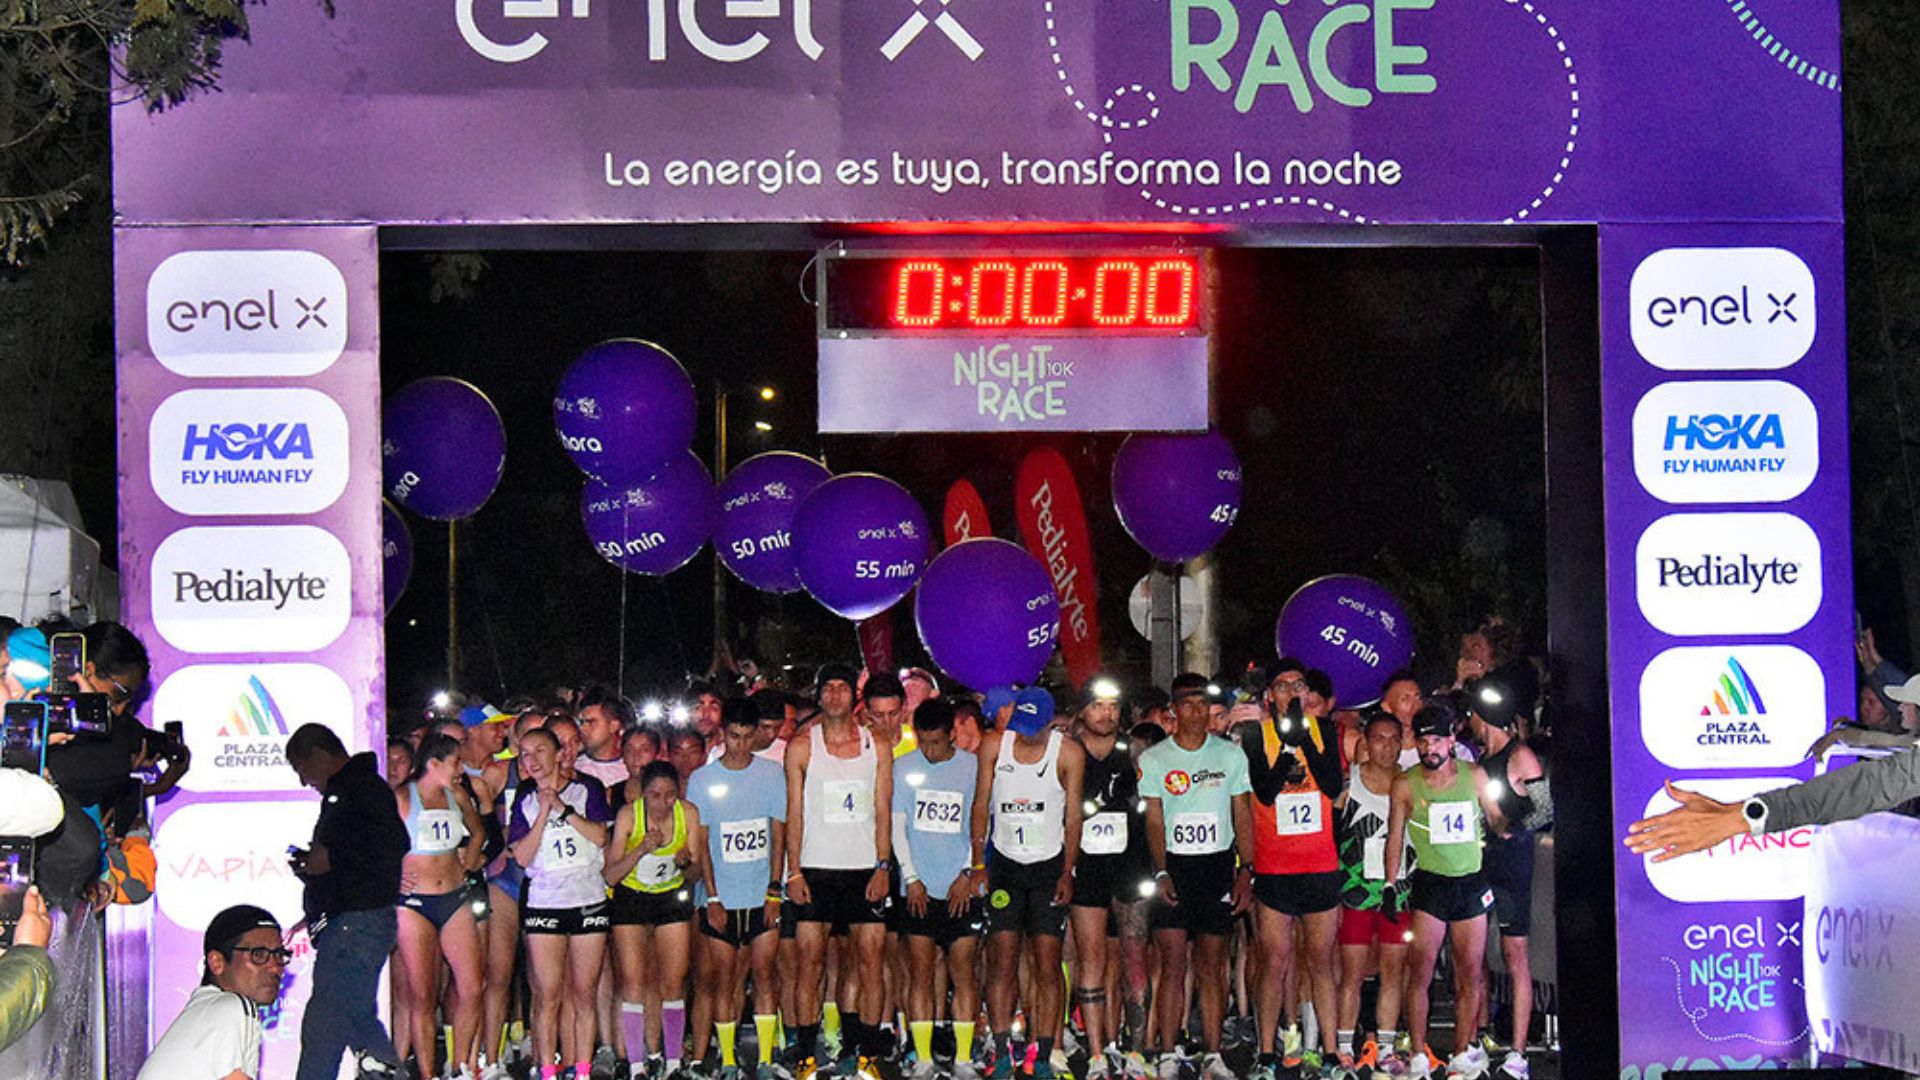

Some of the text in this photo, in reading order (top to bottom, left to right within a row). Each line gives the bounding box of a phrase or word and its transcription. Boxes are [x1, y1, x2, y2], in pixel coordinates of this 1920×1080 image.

[1171, 0, 1437, 113] RACE
[605, 150, 1402, 194] La energía es tuya, transforma la noche
[166, 289, 279, 333] enel
[1648, 285, 1752, 329] enel
[954, 344, 1074, 387] NIGHT 10K
[978, 381, 1067, 422] RACE
[182, 423, 314, 461] HOKA
[1664, 413, 1785, 451] HOKA
[182, 468, 313, 484] FLY HUMAN FLY
[1664, 458, 1785, 473] FLY HUMAN FLY
[625, 531, 667, 556] min
[730, 537, 756, 560] 50
[855, 558, 916, 579] 55 min
[1031, 479, 1088, 642] Pedialyte
[1657, 553, 1799, 594] Pedialyte
[173, 568, 328, 611] Pedialyte
[1027, 622, 1050, 648] 55
[1320, 623, 1348, 646] 45
[1346, 638, 1380, 669] min
[1696, 733, 1771, 746] CENTRAL
[1706, 721, 1762, 734] PLAZA
[223, 743, 283, 755] PLAZA
[842, 792, 855, 812] 4
[915, 800, 962, 823] 7632
[1289, 804, 1312, 824] 12
[431, 820, 451, 841] 11
[1014, 826, 1025, 845] 1
[1173, 823, 1218, 844] 6301
[1442, 813, 1464, 833] 14
[552, 837, 577, 859] 15
[723, 829, 768, 852] 7625
[655, 863, 668, 878] 2
[1683, 916, 1766, 950] enel
[1816, 905, 1870, 970] enel
[1690, 953, 1781, 986] NIGHT 10K
[1708, 980, 1776, 1013] RACE
